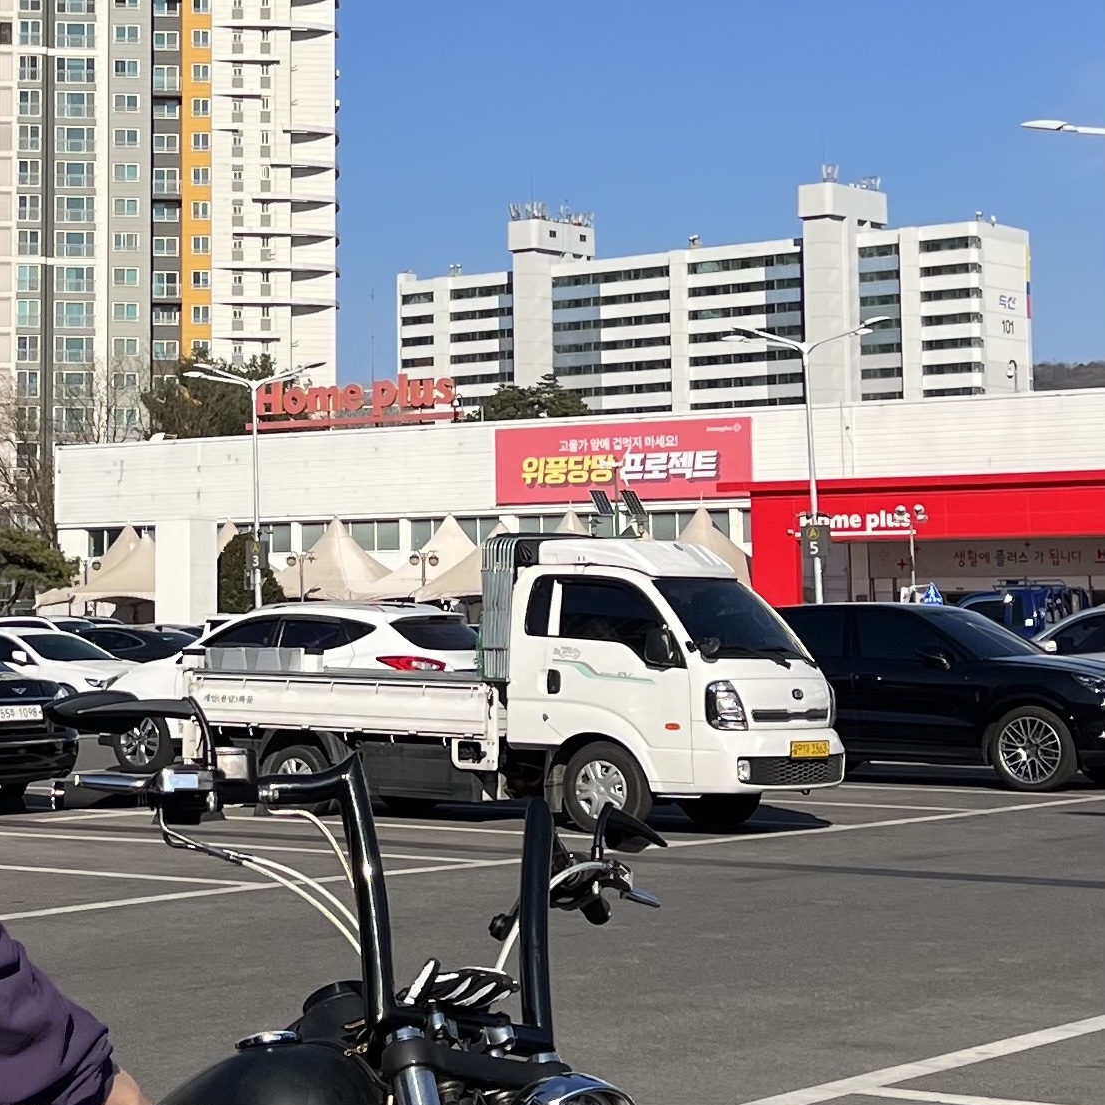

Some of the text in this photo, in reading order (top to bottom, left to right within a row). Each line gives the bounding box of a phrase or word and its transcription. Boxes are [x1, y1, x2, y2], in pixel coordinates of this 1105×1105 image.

[1001, 319, 1015, 335] 101
[256, 373, 455, 419] Home plus
[559, 435, 679, 453] 고물가 앞에 겁먹지 마세요!
[620, 450, 718, 481] 프로젝트
[809, 541, 819, 555] 5
[252, 555, 260, 567] 3
[953, 549, 1082, 567] 생활에 플러스 가 됩니다
